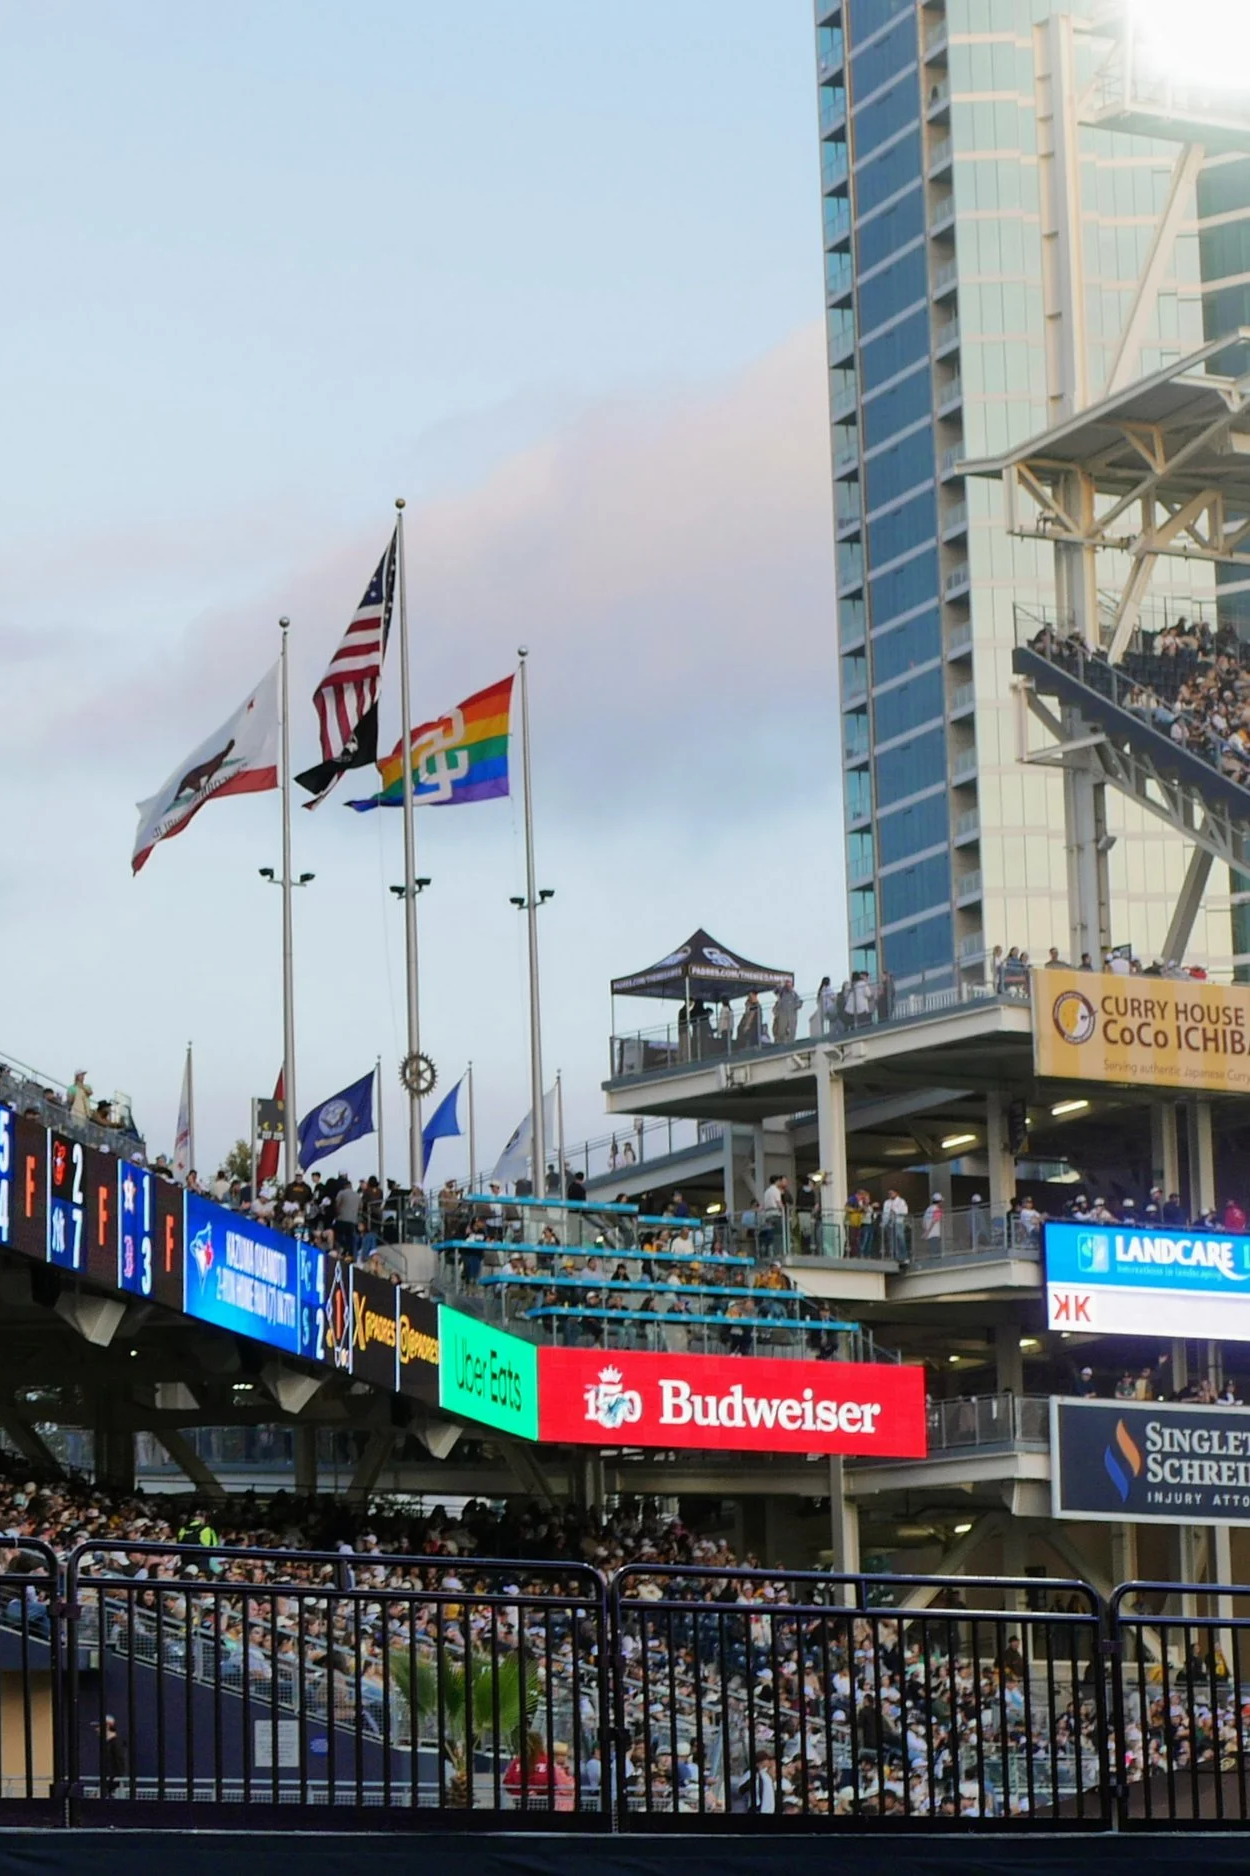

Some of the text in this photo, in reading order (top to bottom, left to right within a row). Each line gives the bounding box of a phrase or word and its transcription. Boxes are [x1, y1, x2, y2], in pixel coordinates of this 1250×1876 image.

[1101, 996, 1168, 1020] CURRY
[1175, 1003, 1245, 1027] HOUSE
[1102, 1019, 1169, 1049] CoCo
[1176, 1026, 1250, 1056] ICHIB
[26, 1155, 36, 1217] F
[72, 1143, 83, 1205] 2
[98, 1187, 109, 1246] F
[143, 1175, 149, 1232] 1
[72, 1208, 83, 1268] 7
[141, 1236, 152, 1294] 3
[166, 1215, 175, 1272] F
[1115, 1235, 1235, 1270] LANDCARE
[316, 1253, 325, 1305] 4
[316, 1308, 325, 1360] 2
[454, 1334, 522, 1412] Uber Eats
[658, 1379, 881, 1434] Budweiser
[1147, 1453, 1250, 1487] SCHREI
[1147, 1492, 1202, 1505] INJURY
